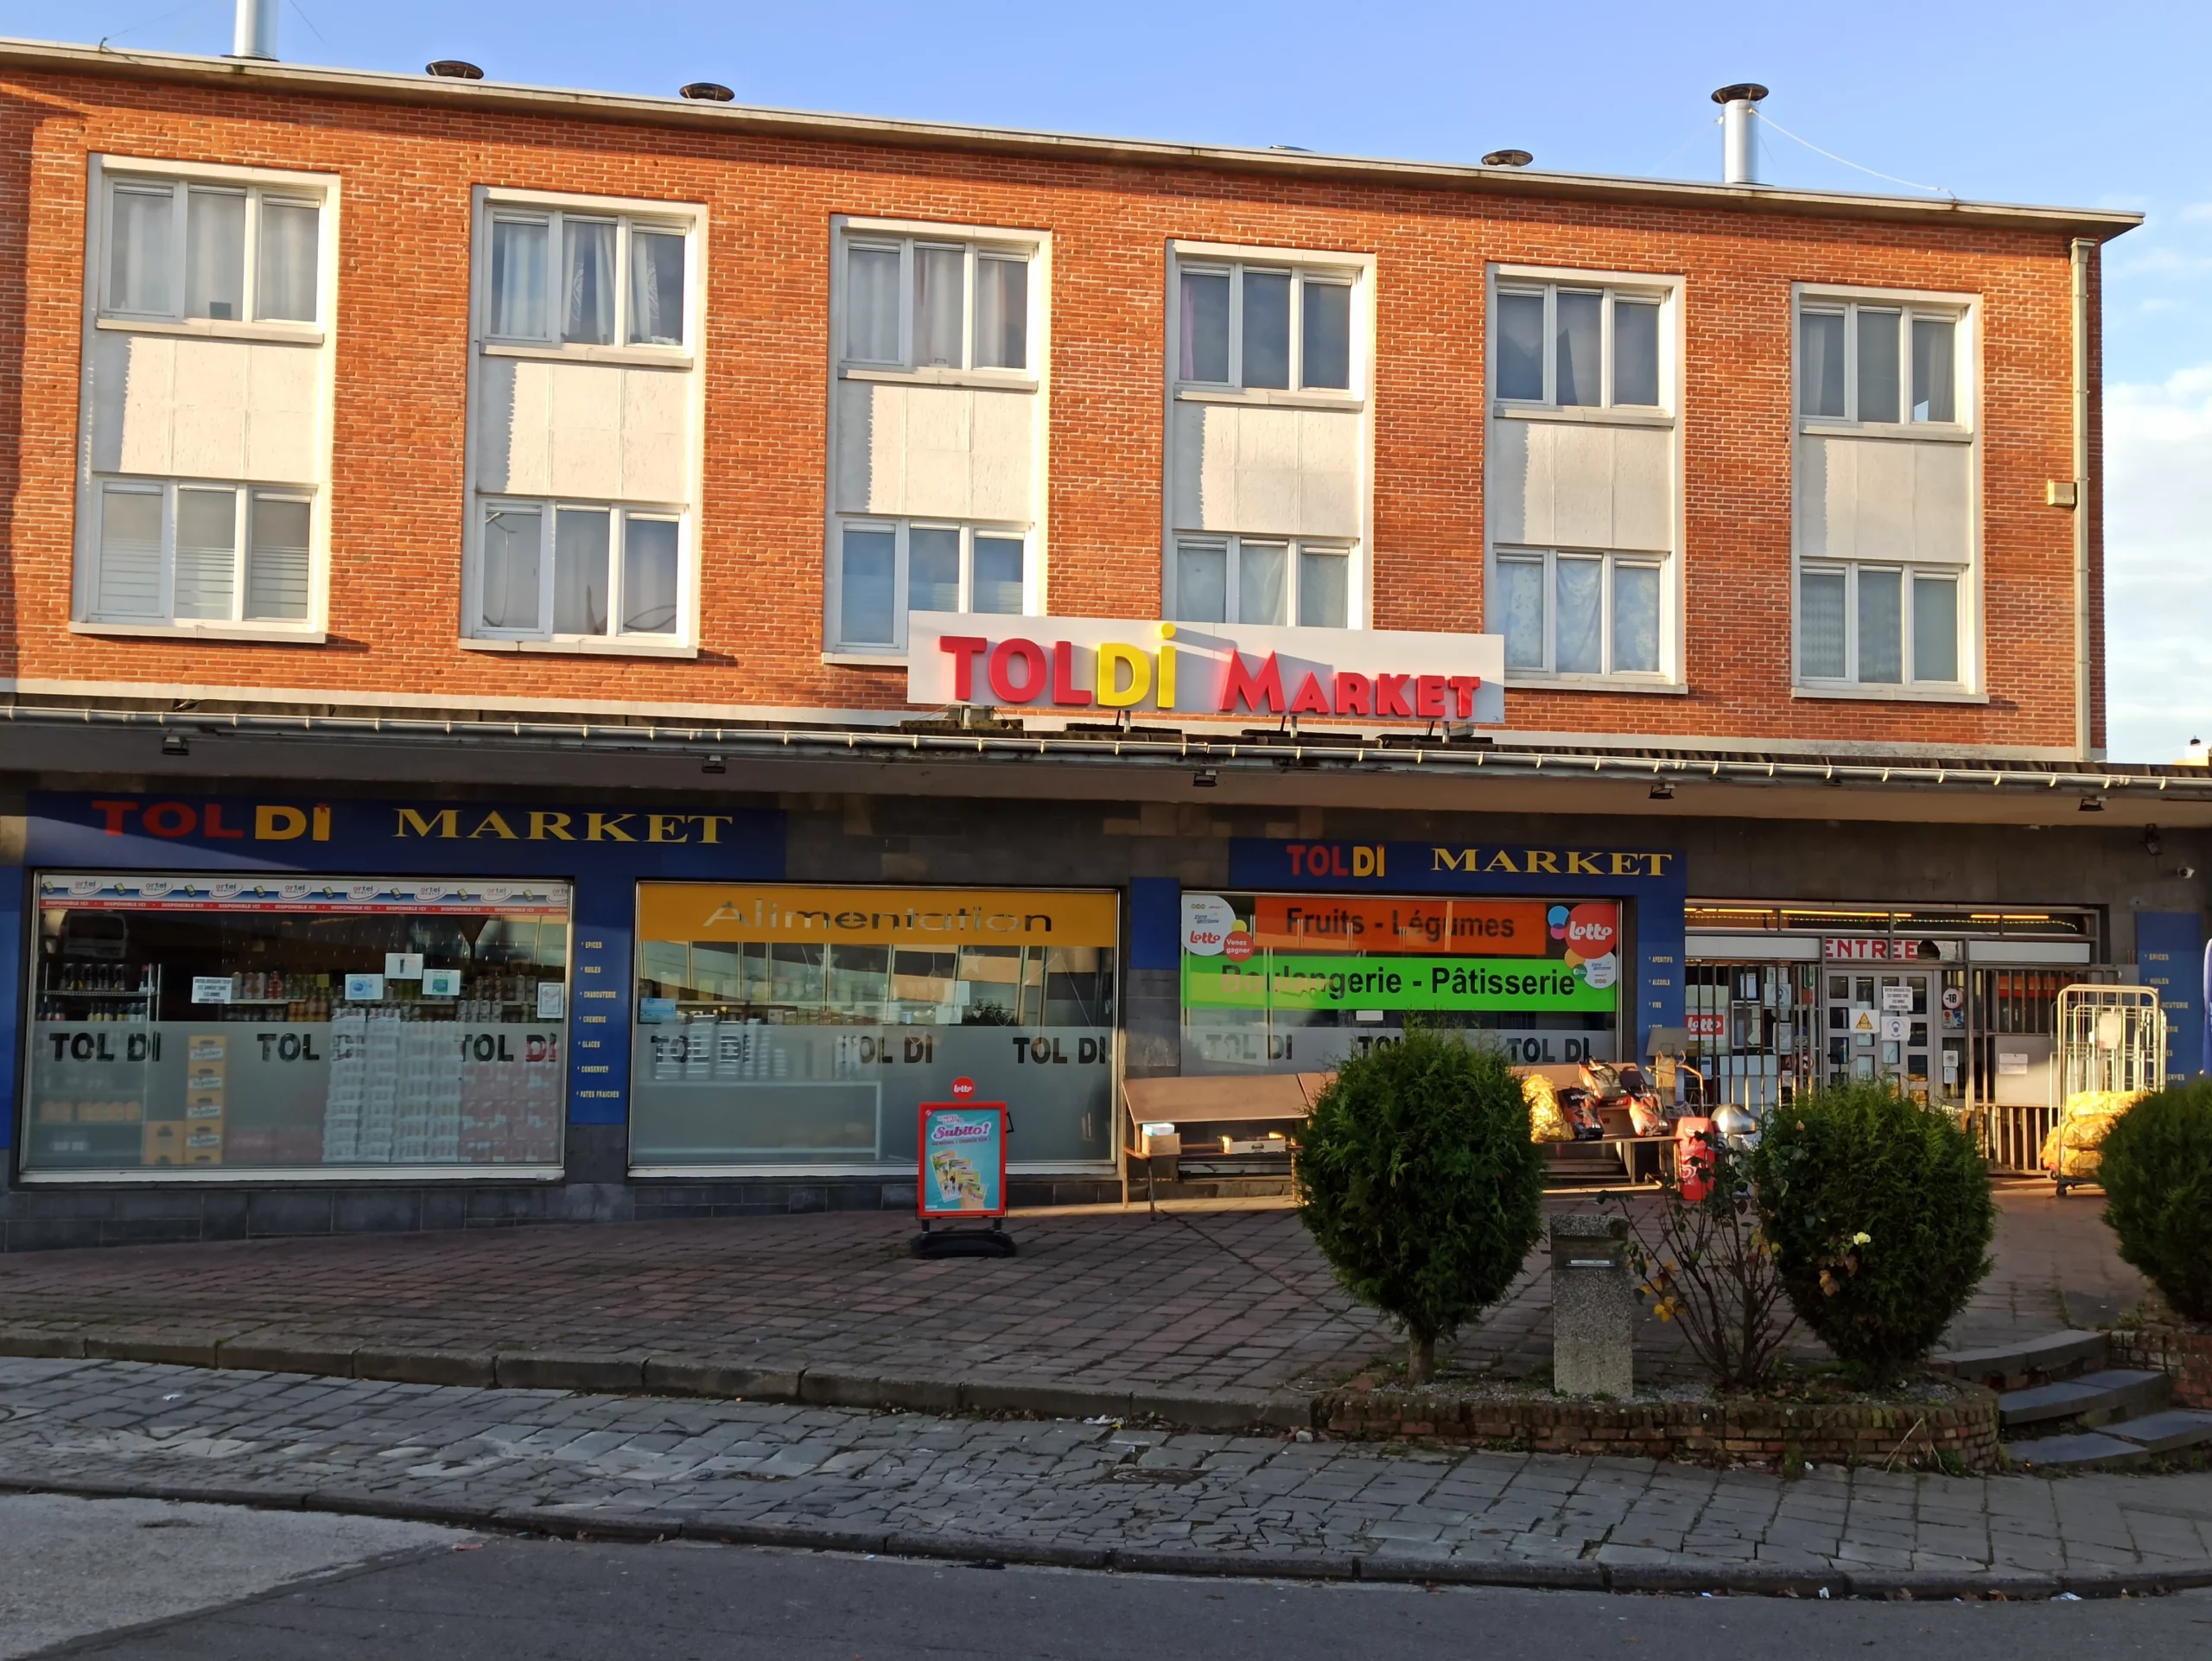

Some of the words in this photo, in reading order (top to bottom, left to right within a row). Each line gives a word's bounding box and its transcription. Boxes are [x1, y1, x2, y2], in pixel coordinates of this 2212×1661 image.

[1218, 649, 1481, 719] MARKET
[392, 808, 733, 843] MARKET
[1430, 848, 1672, 876] MARKET
[702, 898, 1052, 932] Alimentation
[1286, 907, 1365, 935] Fruits
[1392, 908, 1516, 945] Légumes
[1825, 939, 1919, 959] ENTREE
[1221, 964, 1402, 995] Boulangerie
[1432, 966, 1575, 996] Pâtisserie
[1946, 993, 1957, 1003] -18
[49, 1032, 114, 1062] TOL
[256, 1032, 320, 1062] TOL
[455, 1033, 514, 1062] TOL
[1013, 1036, 1068, 1065] TOL
[1205, 1034, 1256, 1060] TOL
[1506, 1037, 1555, 1063] TOL
[933, 1123, 989, 1139] Subito!
